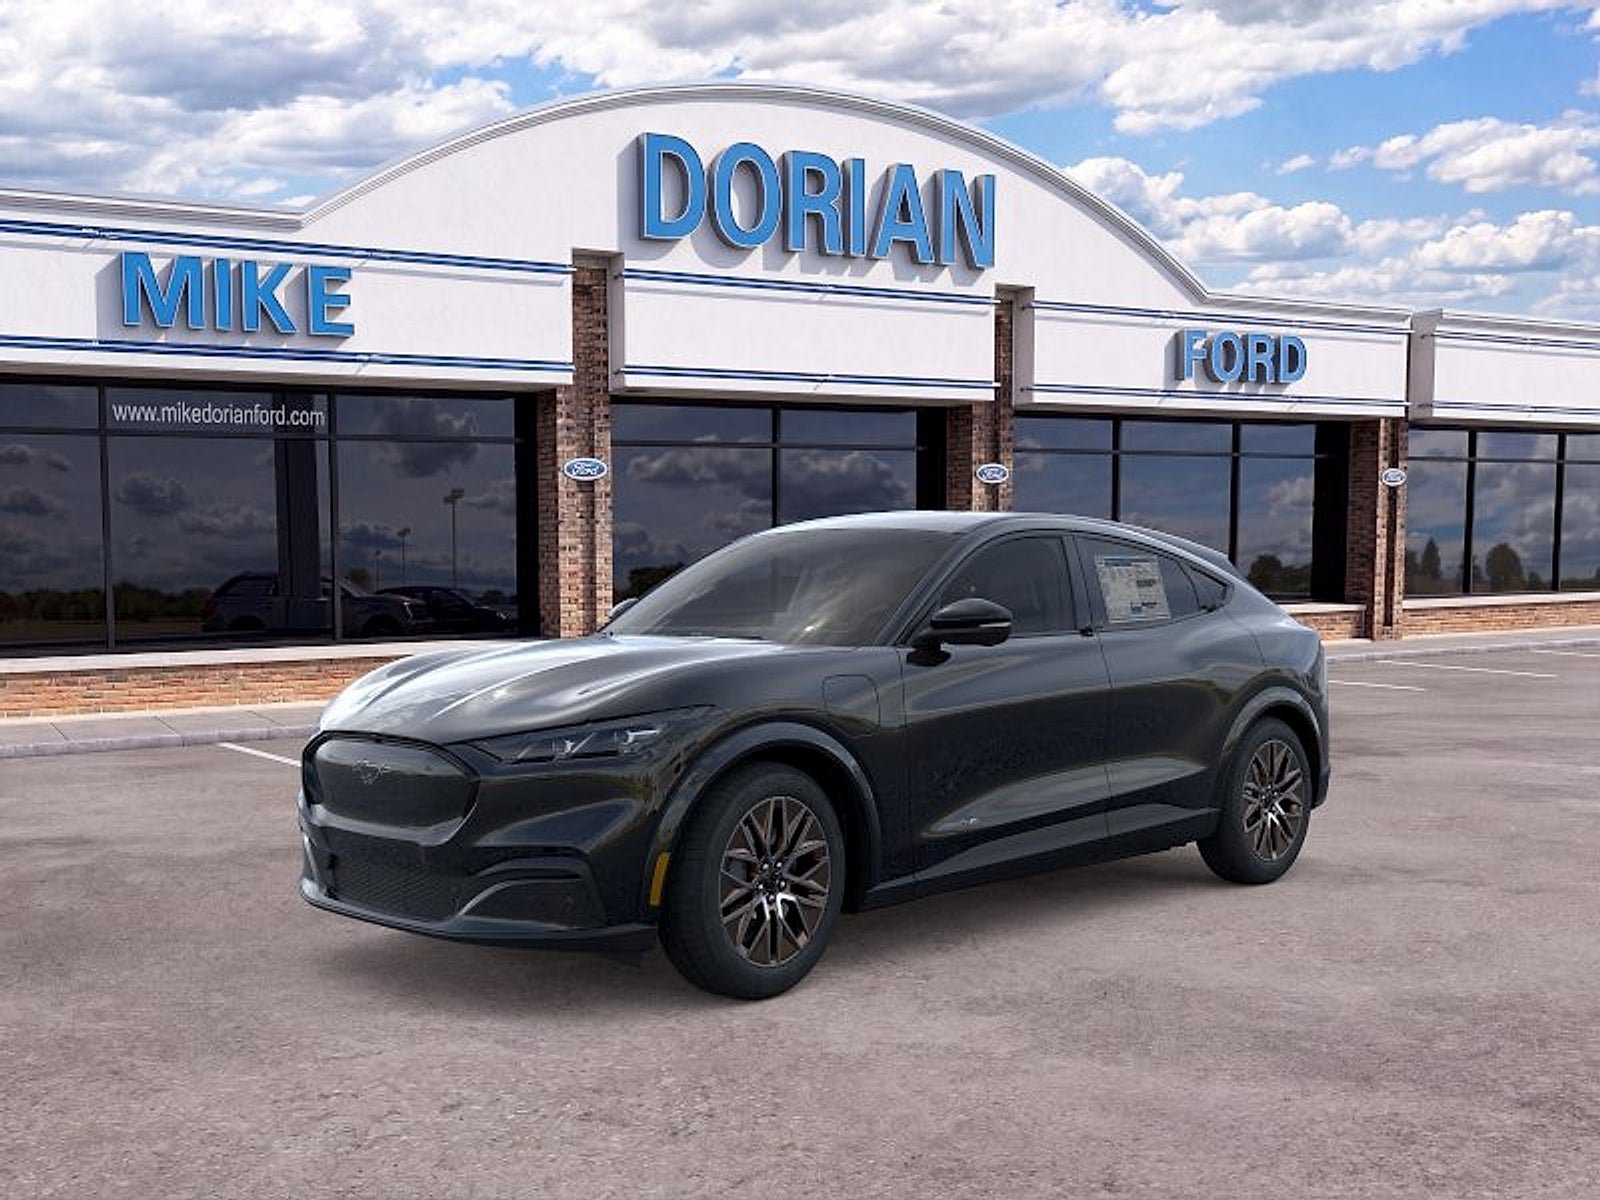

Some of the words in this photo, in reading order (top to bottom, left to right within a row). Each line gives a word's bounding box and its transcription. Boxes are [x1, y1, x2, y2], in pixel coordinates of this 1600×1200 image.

[640, 132, 996, 271] DORIAN
[122, 251, 355, 338] MIKE
[1177, 329, 1308, 384] FORD
[112, 402, 326, 426] www.mikedorianford.com
